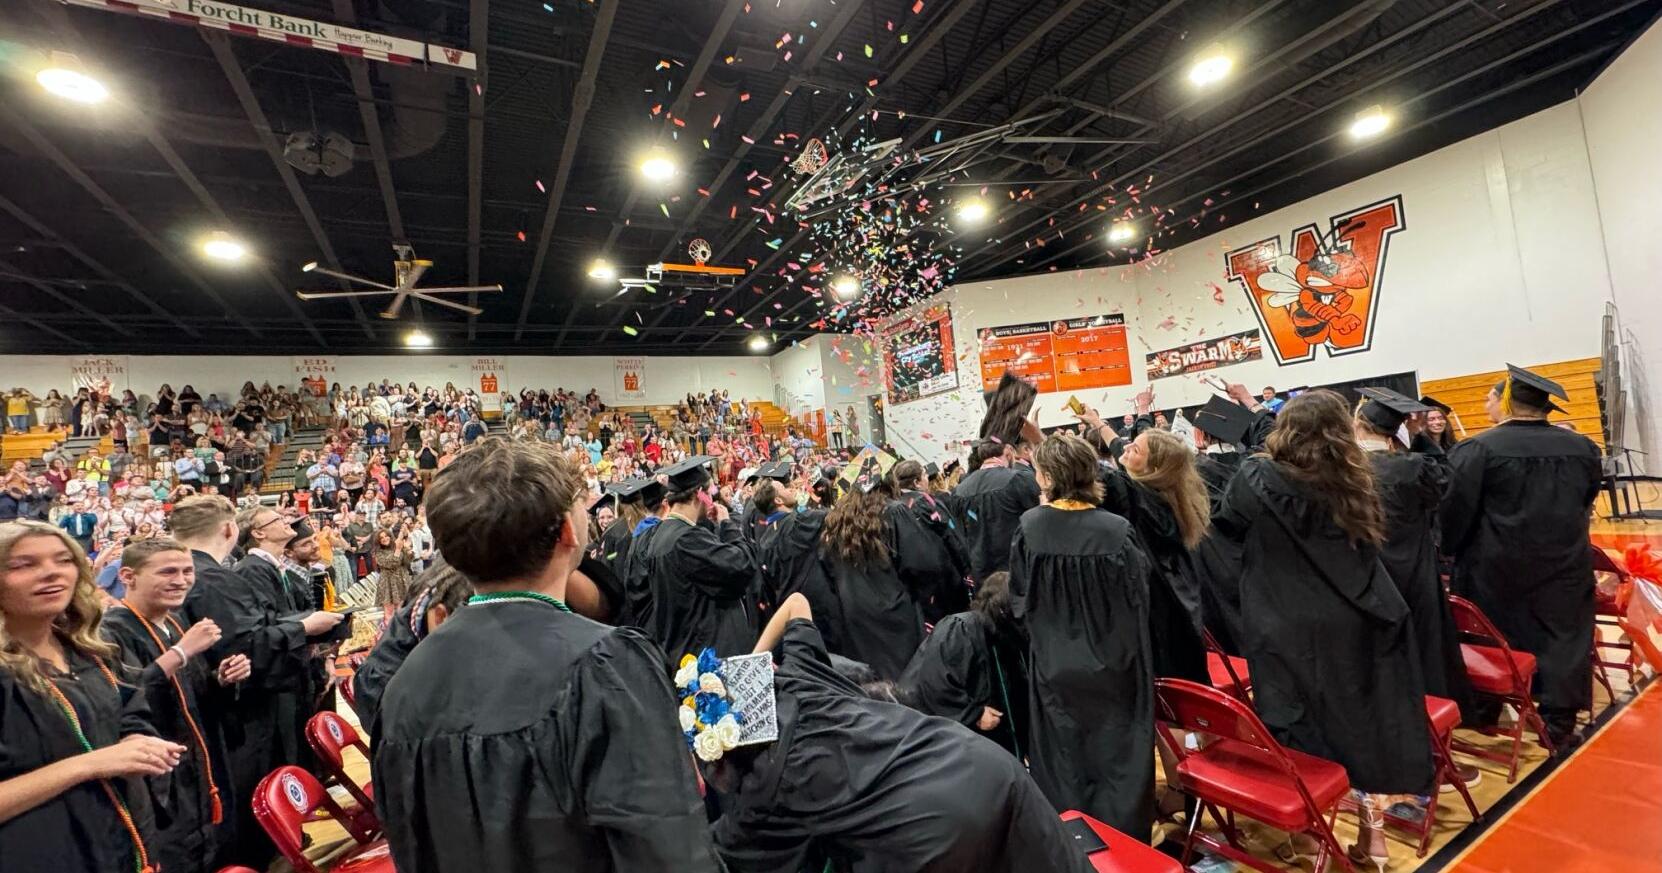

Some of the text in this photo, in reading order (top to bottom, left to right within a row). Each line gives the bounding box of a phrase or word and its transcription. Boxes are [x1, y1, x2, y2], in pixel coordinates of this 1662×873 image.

[187, 0, 328, 38] Forcht Bank
[1320, 294, 1333, 305] W
[1169, 339, 1236, 372] SWARM
[482, 381, 496, 392] 77
[744, 666, 761, 685] GIVE
[742, 687, 756, 701] BUT
